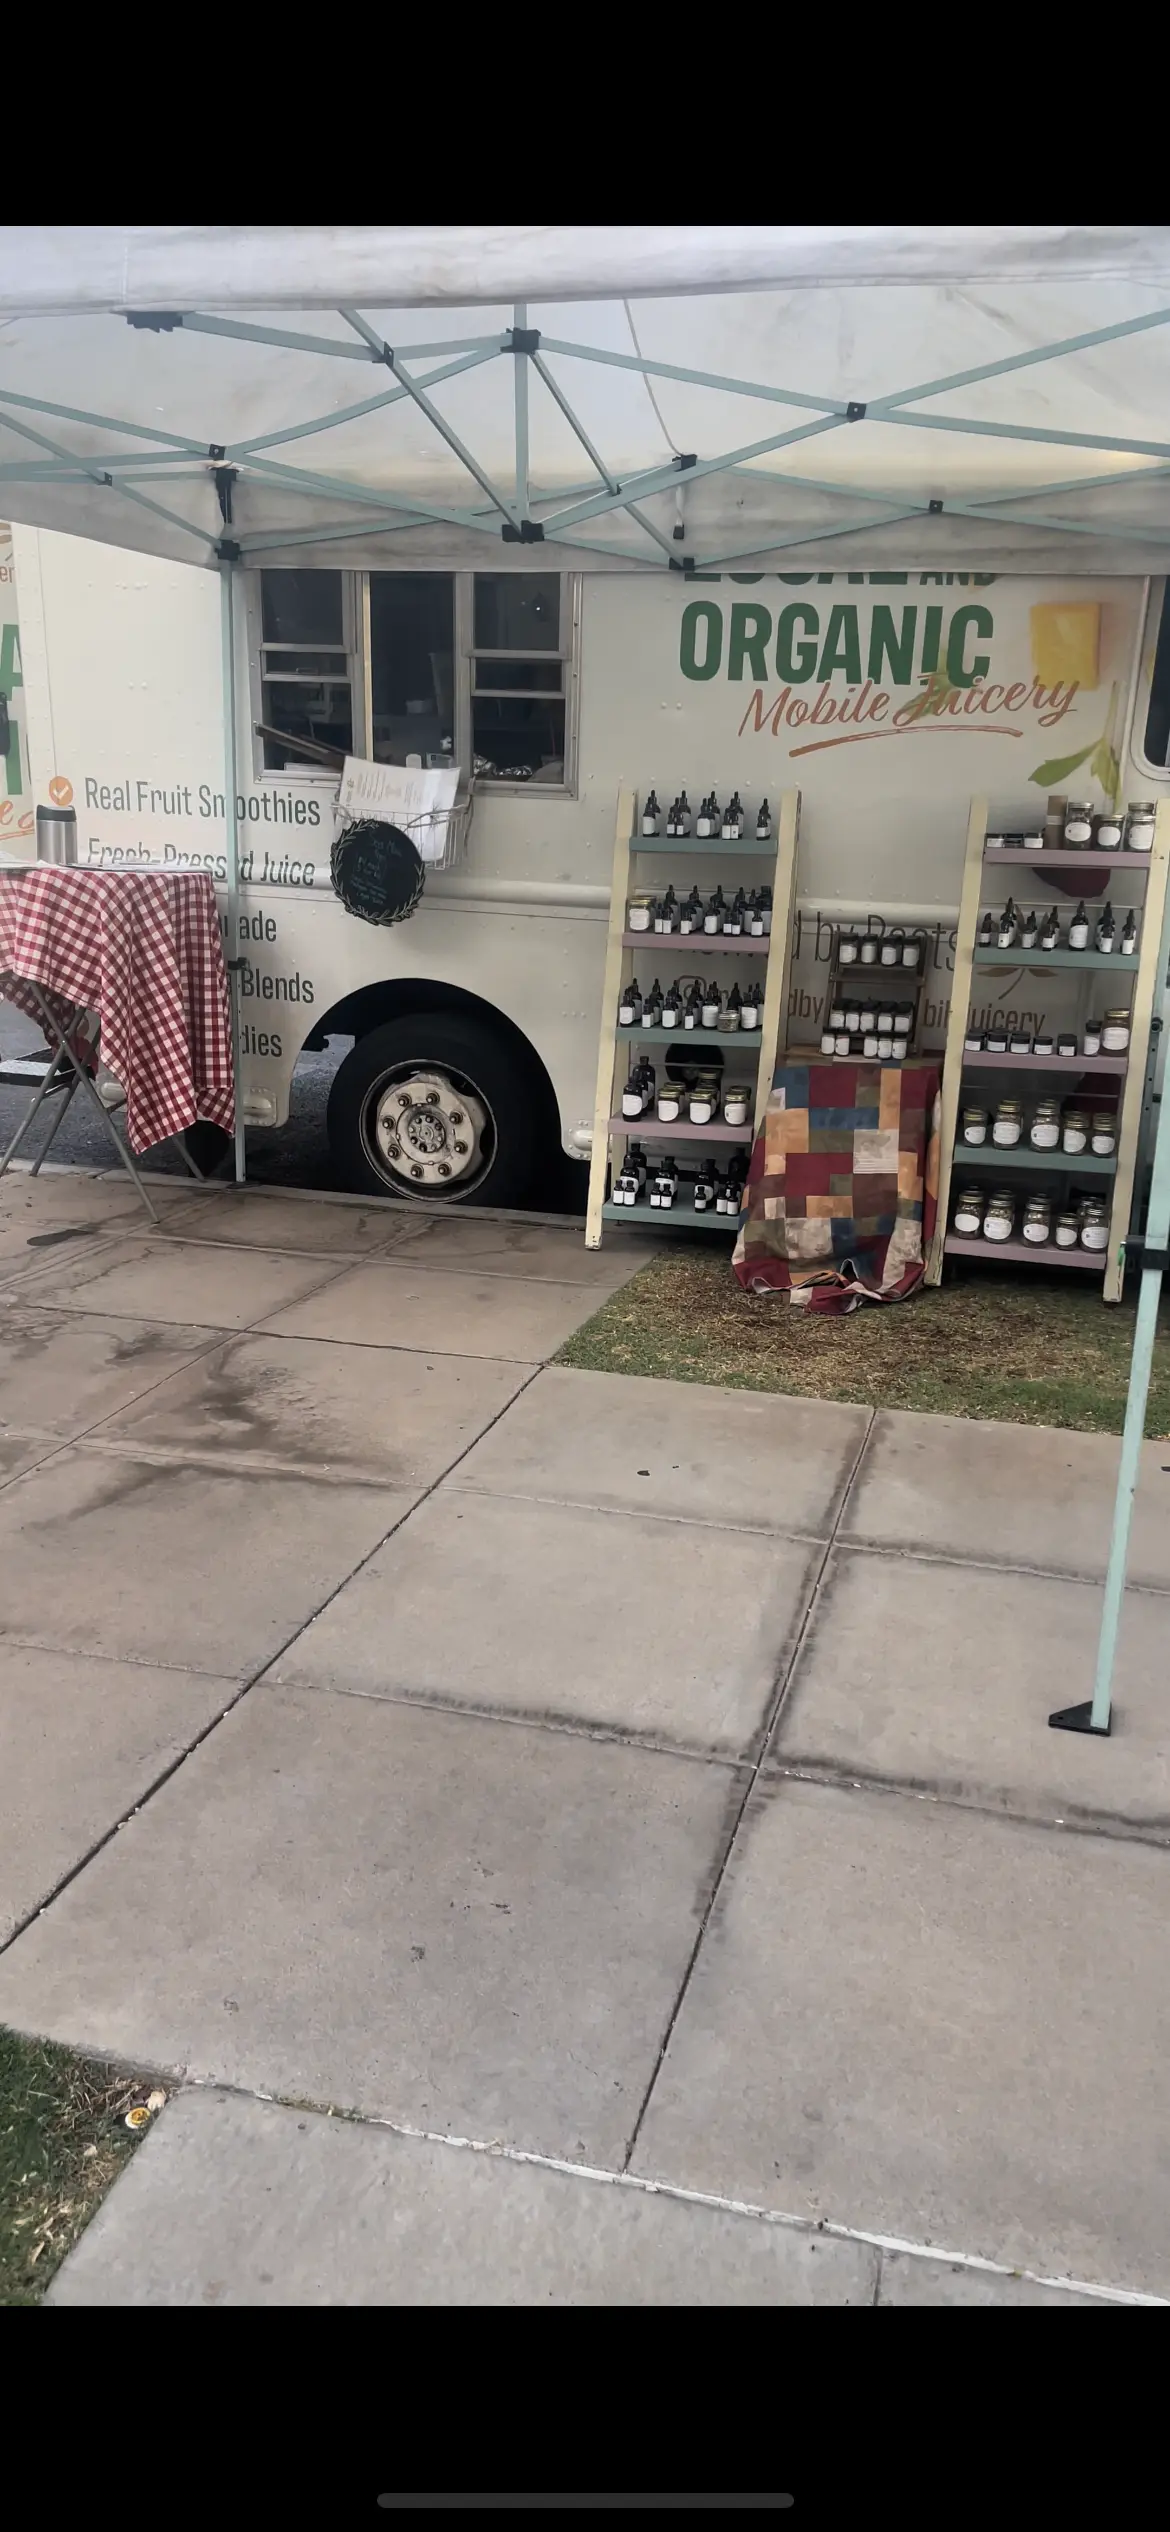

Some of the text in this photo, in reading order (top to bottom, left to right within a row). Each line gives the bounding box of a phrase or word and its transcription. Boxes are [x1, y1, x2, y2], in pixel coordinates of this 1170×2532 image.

[679, 600, 994, 689] ORGANIC
[738, 672, 1080, 738] Mobile Juicery
[85, 777, 131, 812] Real
[136, 780, 193, 816] Fruit
[261, 851, 315, 887] Juice
[241, 968, 314, 1003] Blends
